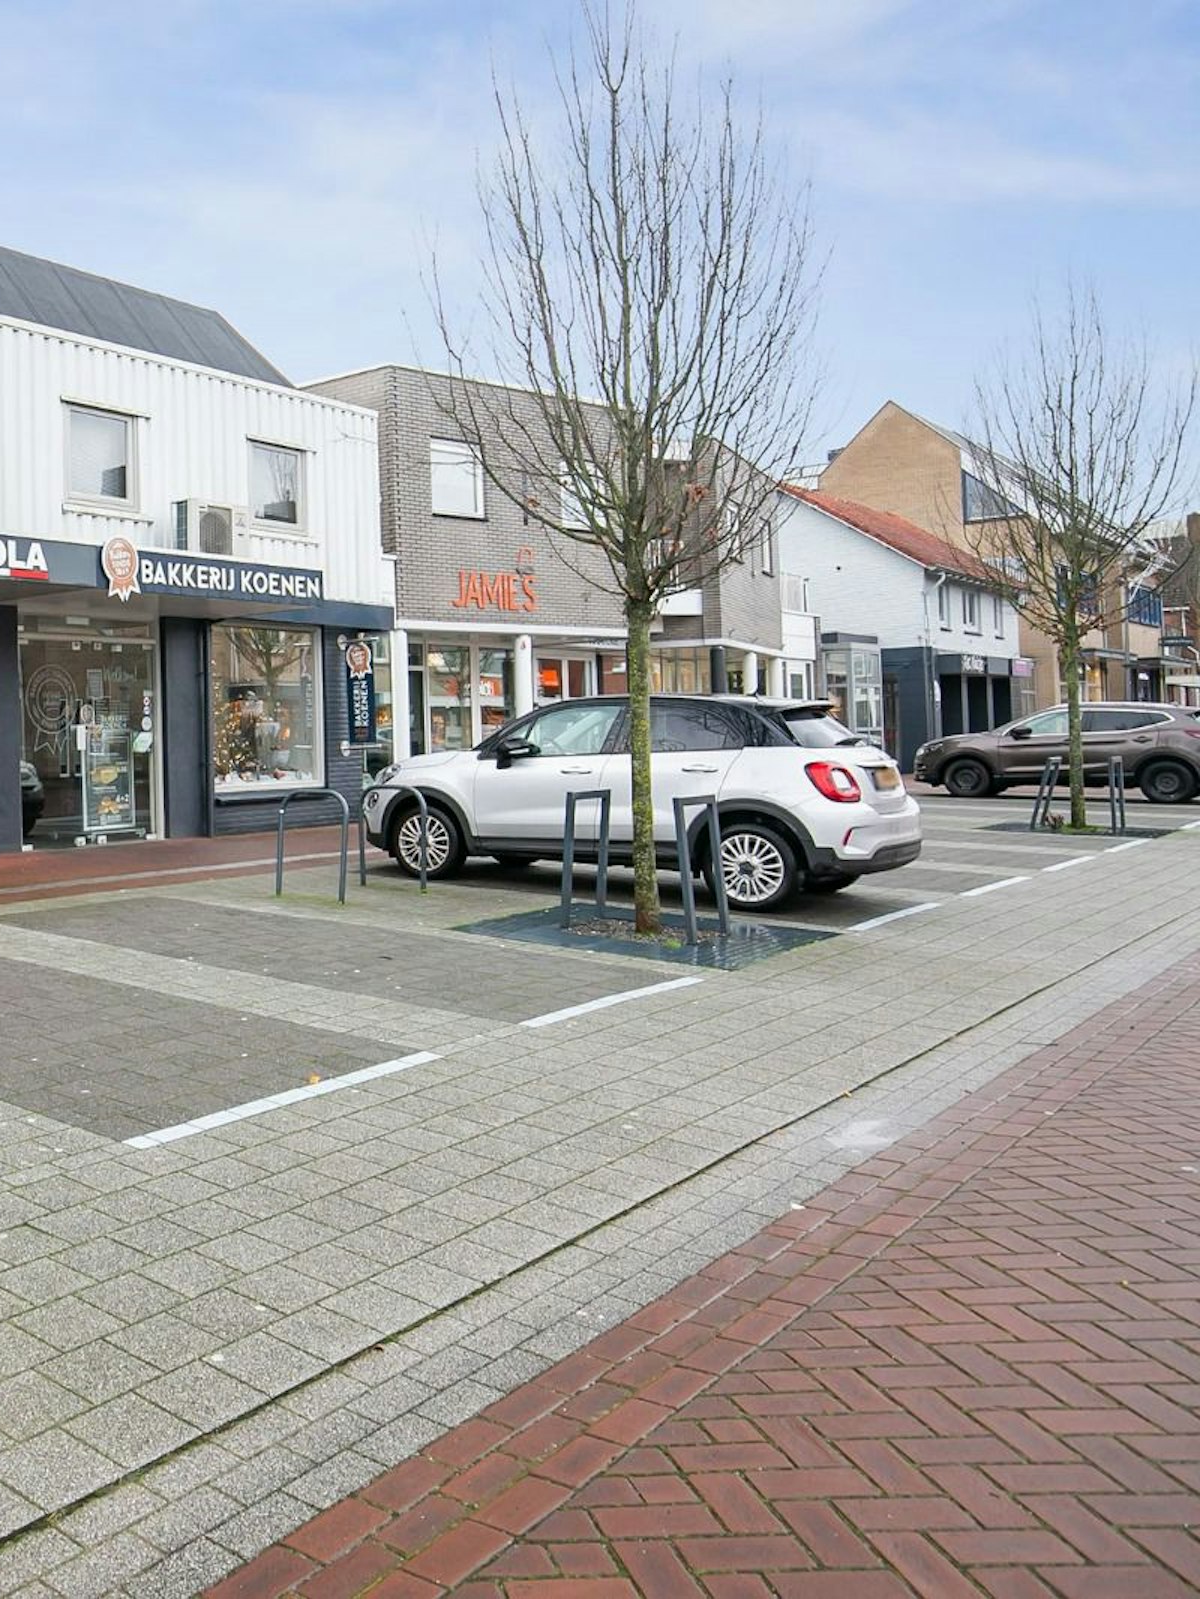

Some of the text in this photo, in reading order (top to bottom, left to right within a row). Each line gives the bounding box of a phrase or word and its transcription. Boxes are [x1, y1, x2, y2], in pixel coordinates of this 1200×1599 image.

[141, 559, 235, 591] BAKKERIJ
[240, 570, 321, 599] KOENEN
[360, 680, 369, 727] KOENEN
